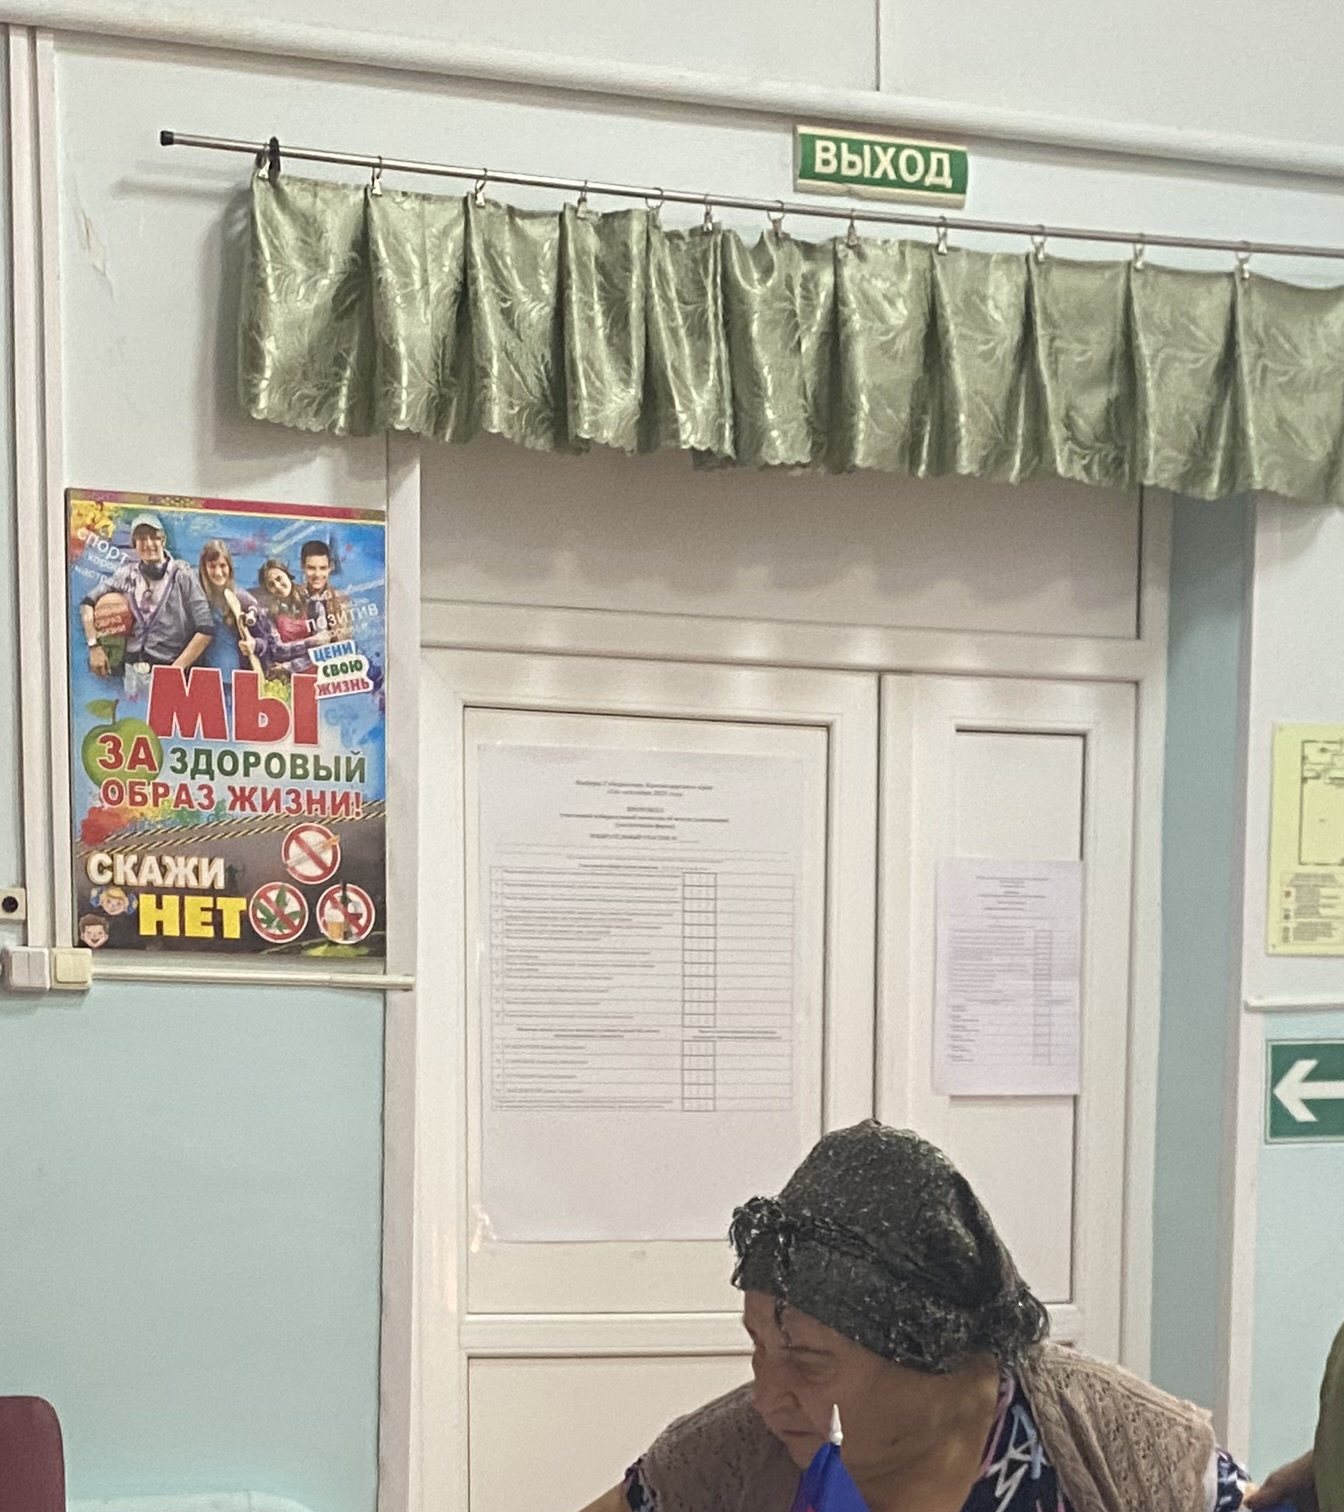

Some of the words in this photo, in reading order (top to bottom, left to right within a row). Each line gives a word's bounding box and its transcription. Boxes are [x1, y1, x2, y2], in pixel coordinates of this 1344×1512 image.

[814, 140, 953, 188] ВЫХОД
[312, 642, 353, 663] ЦЕНИ
[322, 659, 364, 678] СВОЮ
[146, 665, 320, 746] МЫ
[316, 677, 371, 697] ЖИЗНЬ
[97, 733, 158, 772] ЗА
[169, 746, 367, 784] ЗДОРОВЫЙ
[101, 780, 216, 812] ОБРАЗ
[227, 784, 363, 818] ЖИЗНИ!
[86, 852, 226, 889] СКАЖИ
[138, 893, 248, 940] НЕТ
